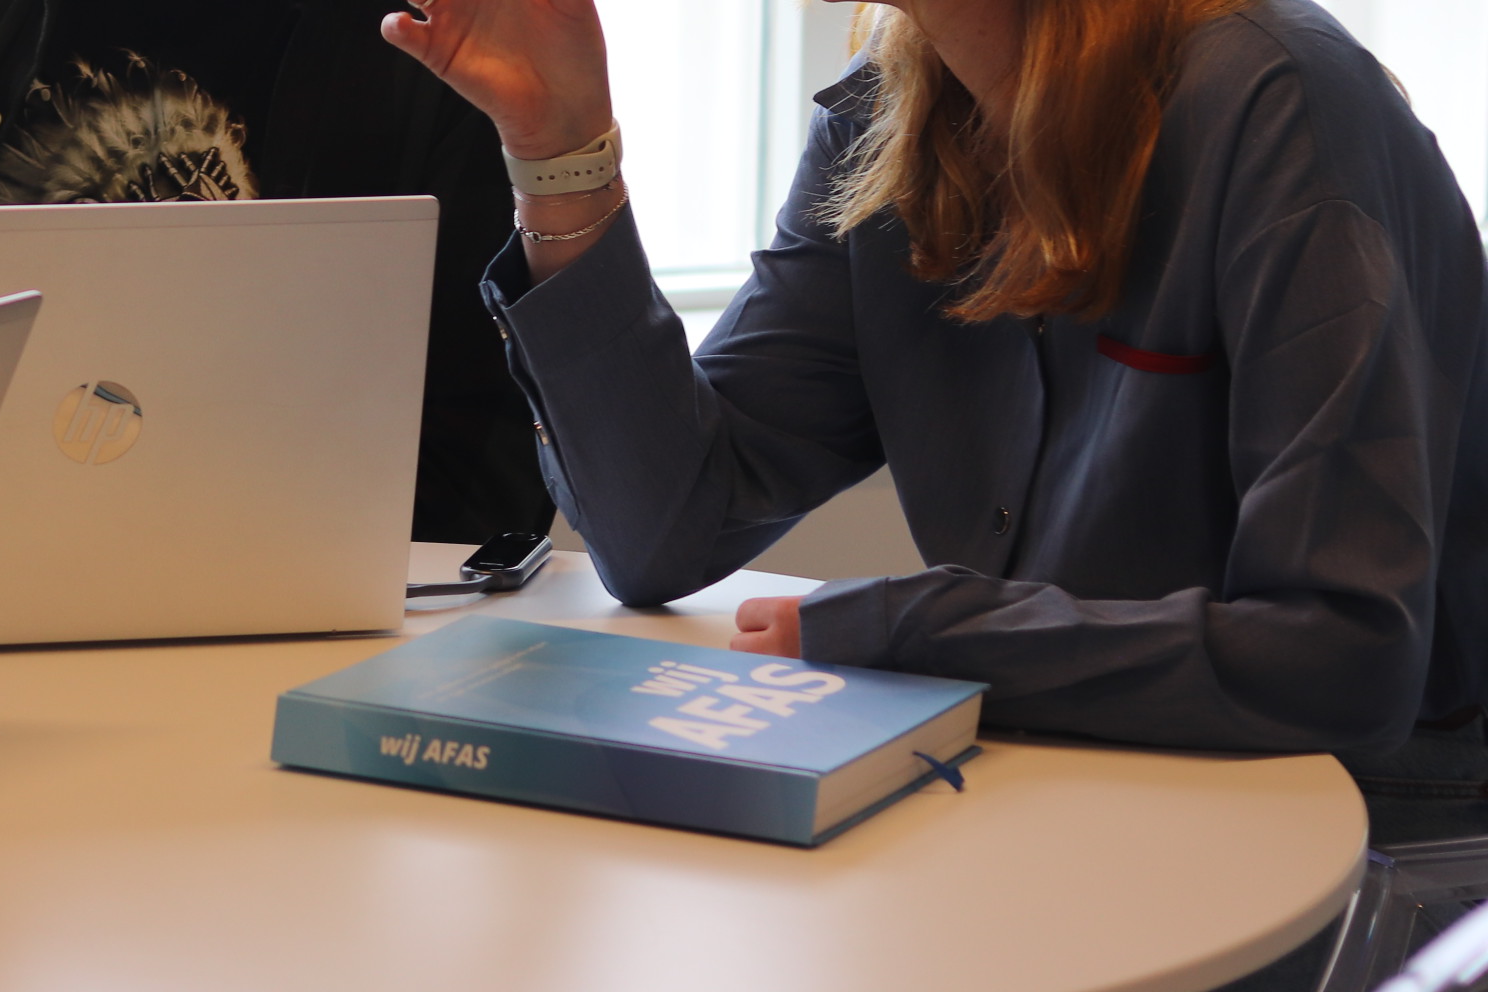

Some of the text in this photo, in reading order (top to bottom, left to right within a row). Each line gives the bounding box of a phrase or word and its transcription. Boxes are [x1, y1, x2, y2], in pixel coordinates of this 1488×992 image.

[60, 381, 136, 465] hp
[630, 661, 739, 698] wij
[648, 663, 846, 750] AFAS
[380, 733, 490, 769] wij AFAS
